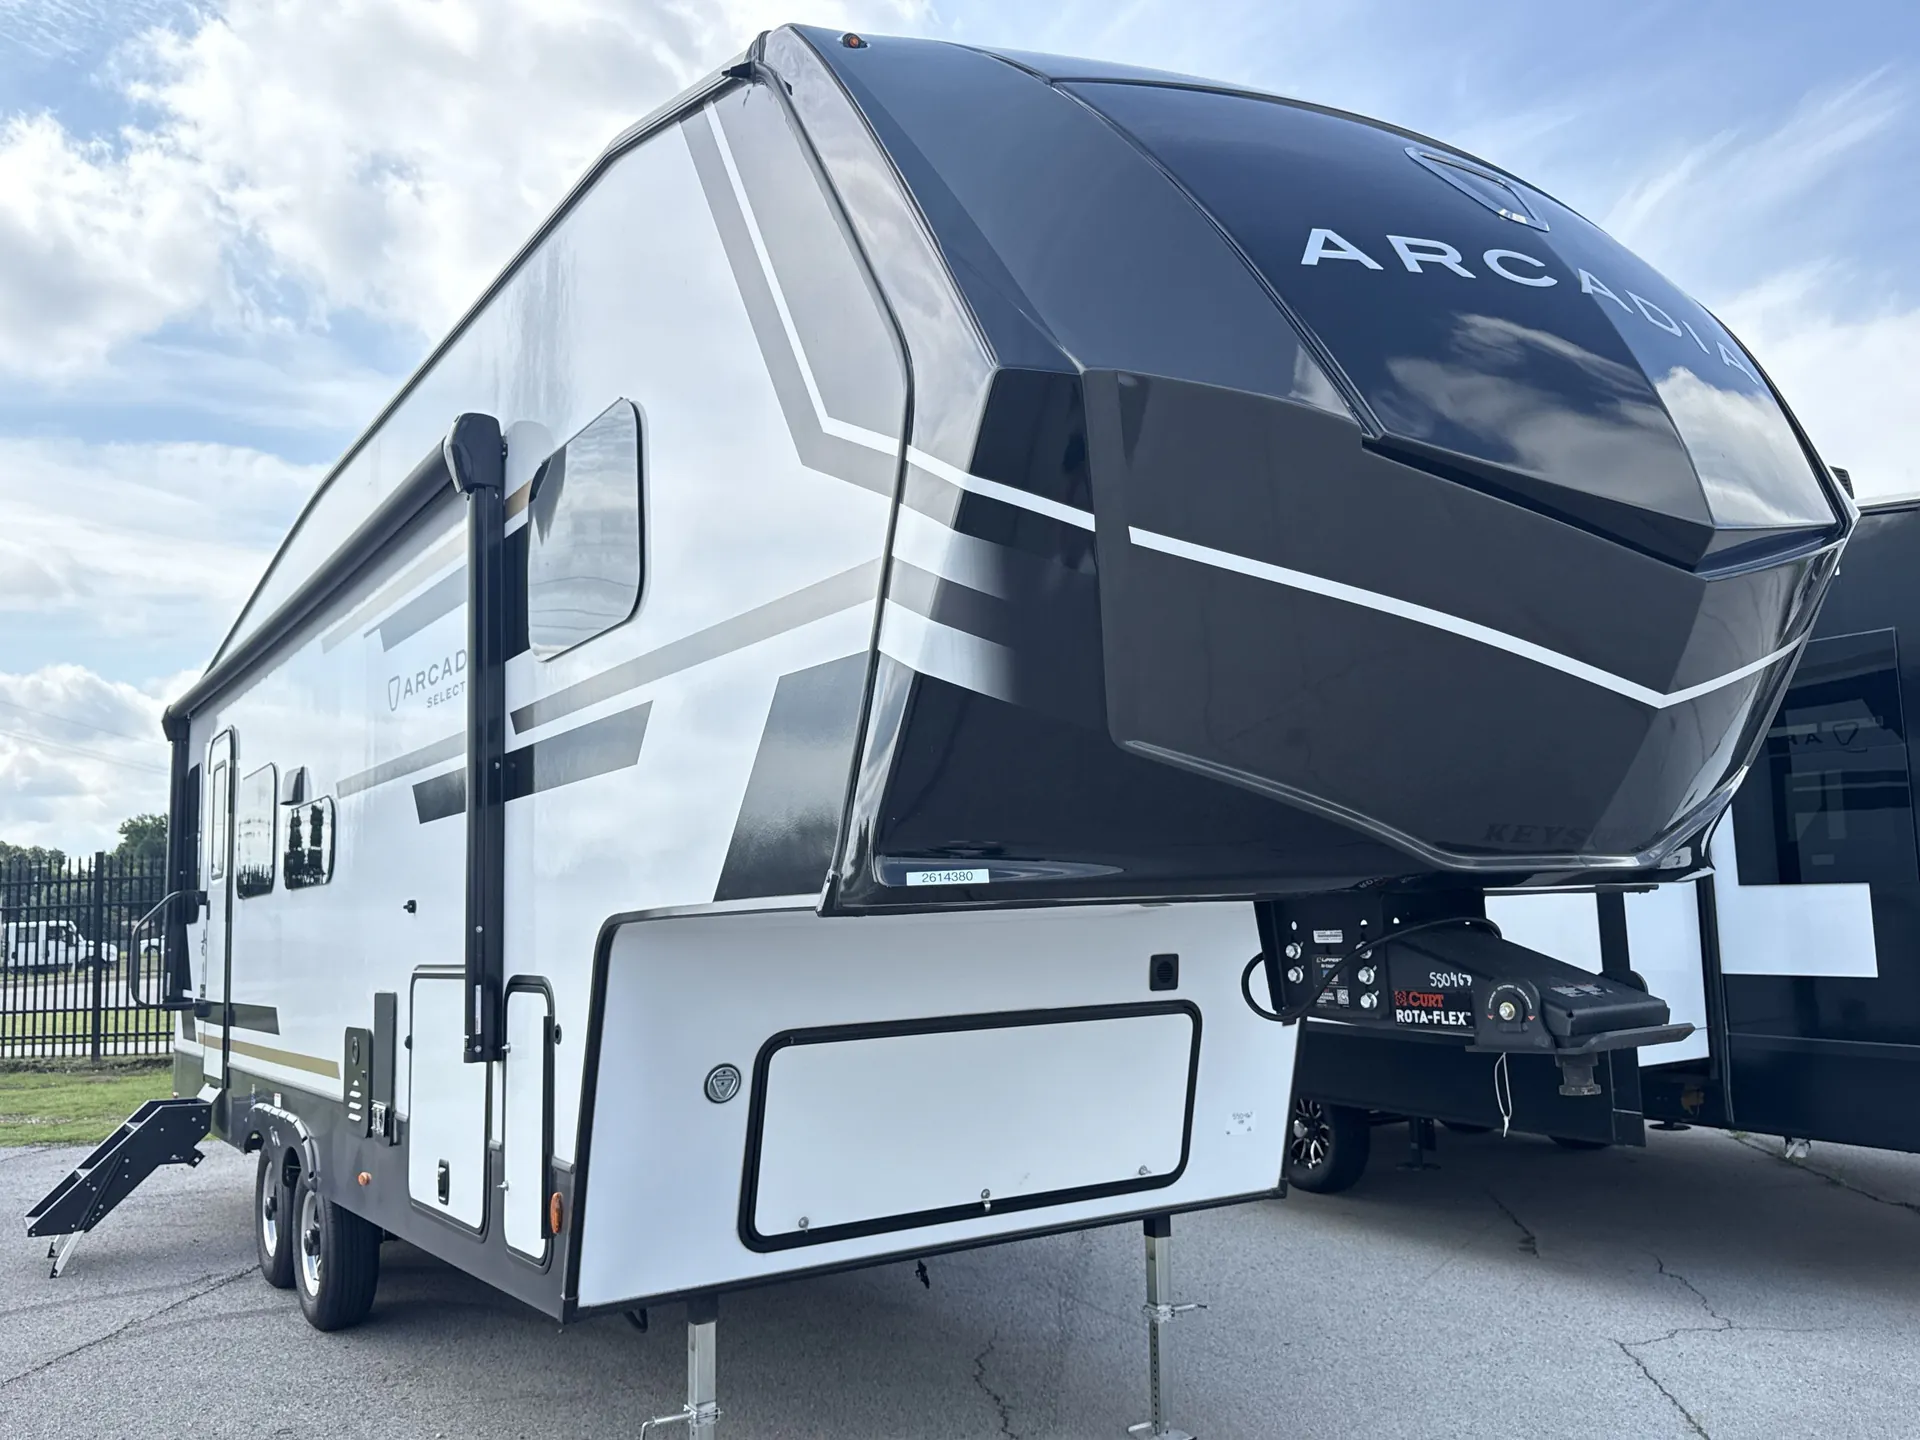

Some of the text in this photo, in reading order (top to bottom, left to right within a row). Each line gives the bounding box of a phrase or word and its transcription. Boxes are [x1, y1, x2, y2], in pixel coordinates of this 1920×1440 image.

[1300, 227, 1759, 386] ARCADIA
[426, 680, 466, 708] SELECT
[921, 870, 974, 883] 2614380
[1408, 991, 1444, 1008] CURT
